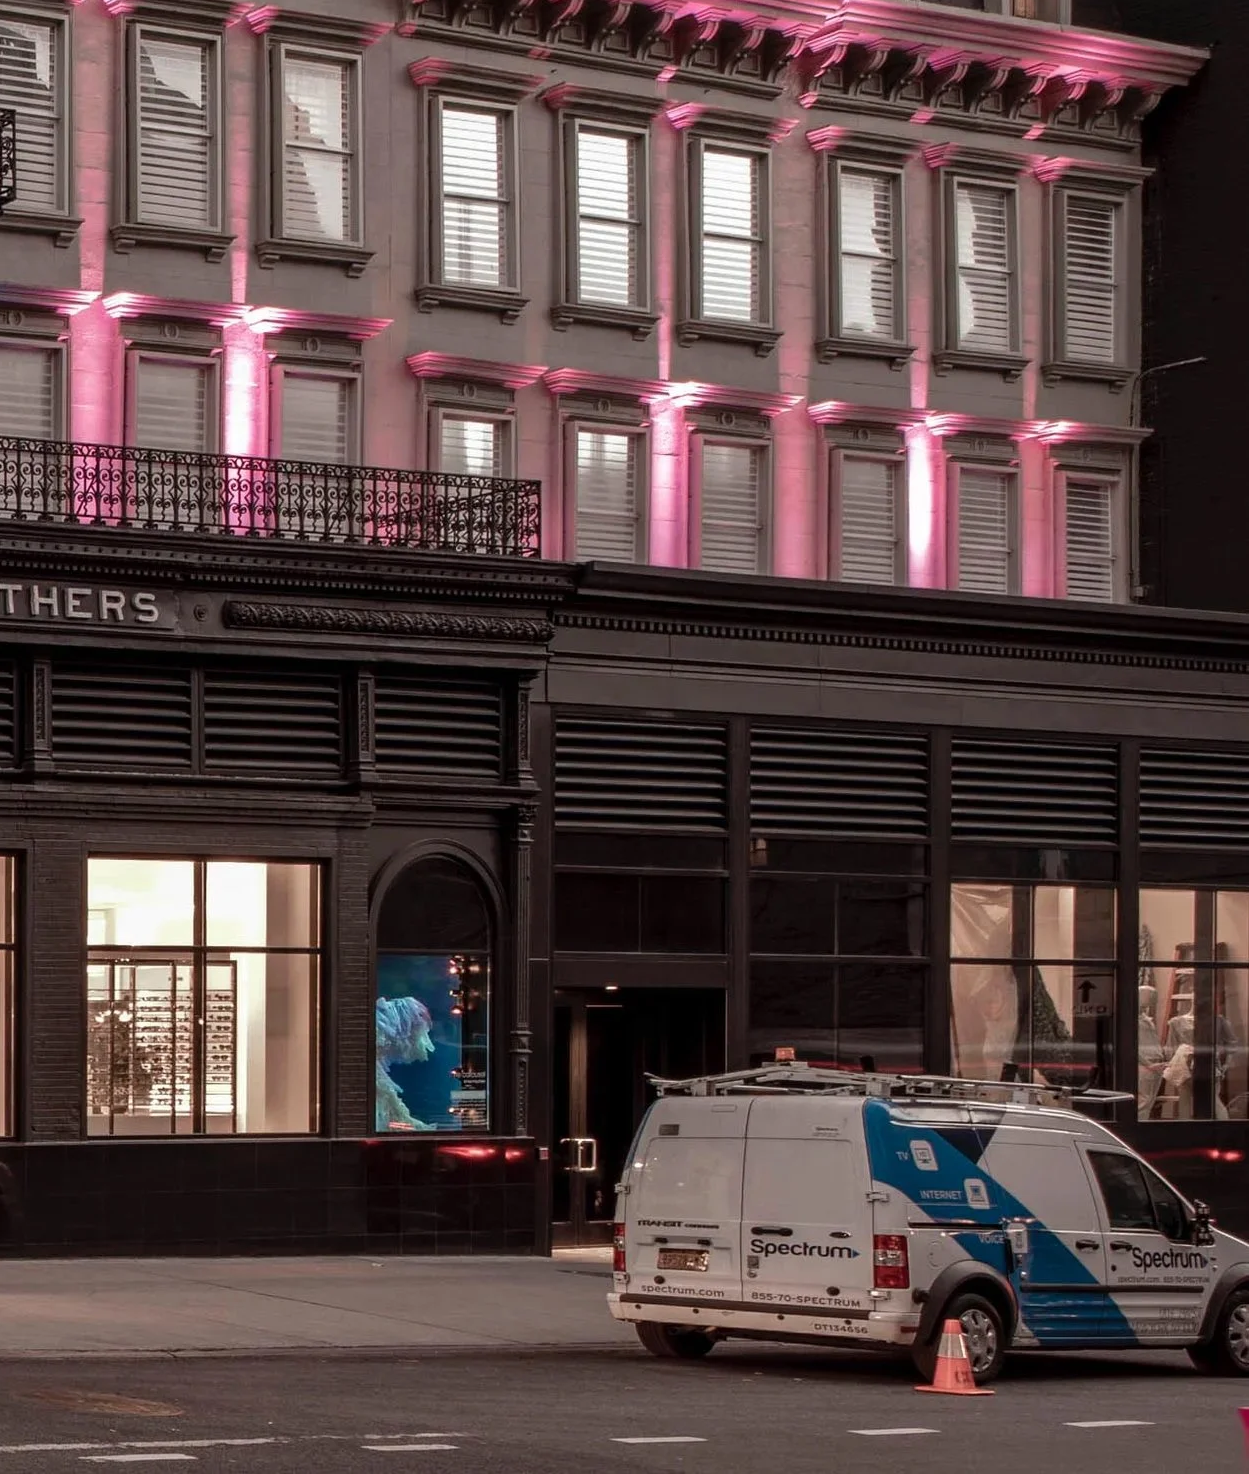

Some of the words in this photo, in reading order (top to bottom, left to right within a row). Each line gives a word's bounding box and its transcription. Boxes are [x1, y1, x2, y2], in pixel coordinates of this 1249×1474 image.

[896, 1151, 909, 1161] TV
[919, 1190, 963, 1200] INTERNET
[637, 1219, 683, 1228] TRANSIT
[750, 1239, 852, 1259] Spectrum
[1131, 1247, 1204, 1274] Spectrum
[641, 1284, 725, 1298] spectrum.com
[751, 1291, 861, 1308] 855-70-SPECTRUM
